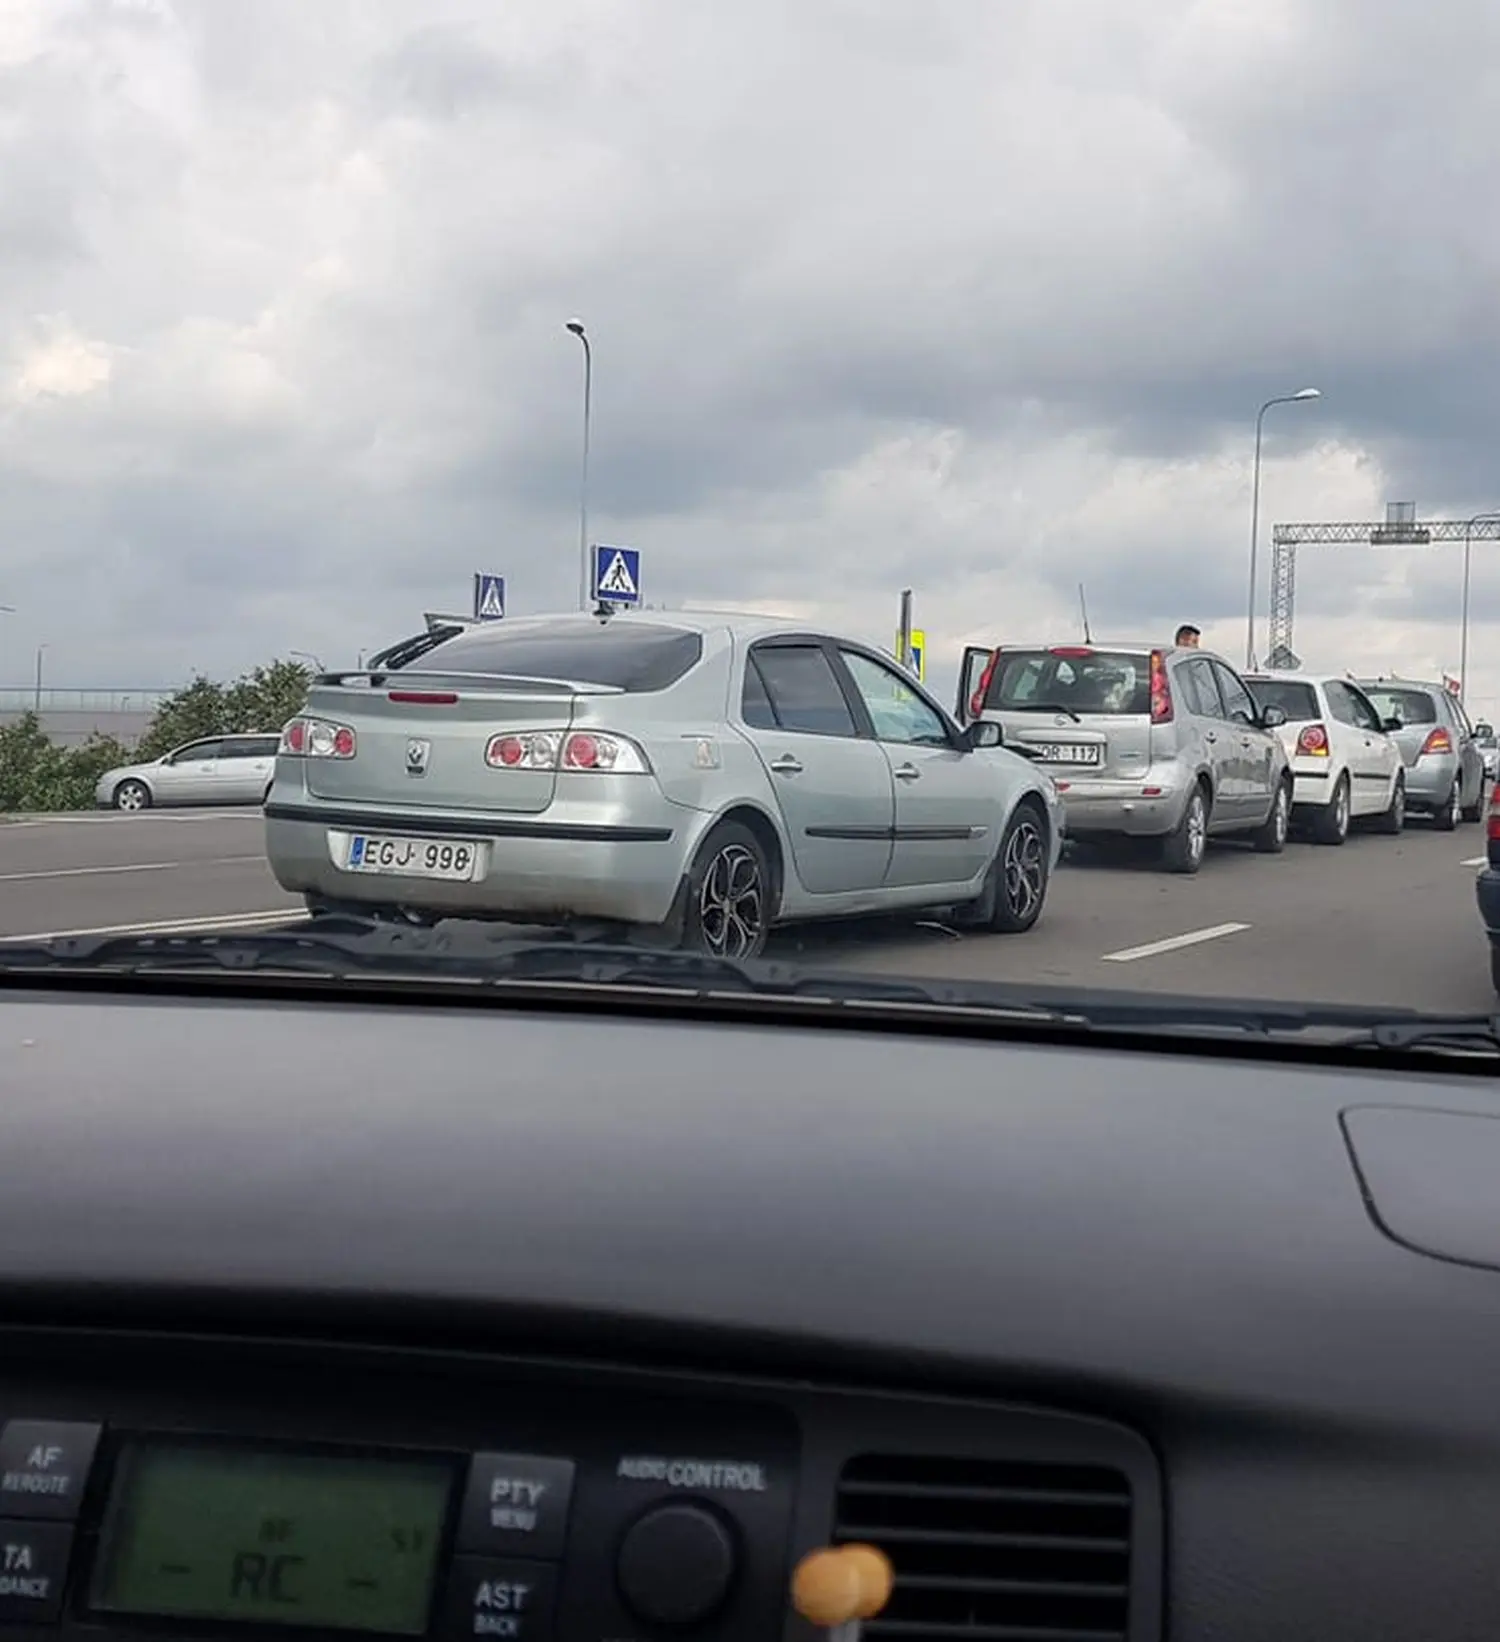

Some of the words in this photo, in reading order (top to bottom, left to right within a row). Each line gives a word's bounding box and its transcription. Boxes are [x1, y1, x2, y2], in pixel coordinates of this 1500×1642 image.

[364, 840, 412, 866] EGJ
[424, 845, 470, 871] 998
[27, 1445, 62, 1469] AF
[668, 1460, 767, 1491] CONTROL
[490, 1478, 545, 1506] PTY
[5, 1544, 32, 1571] TA
[473, 1580, 529, 1610] AST
